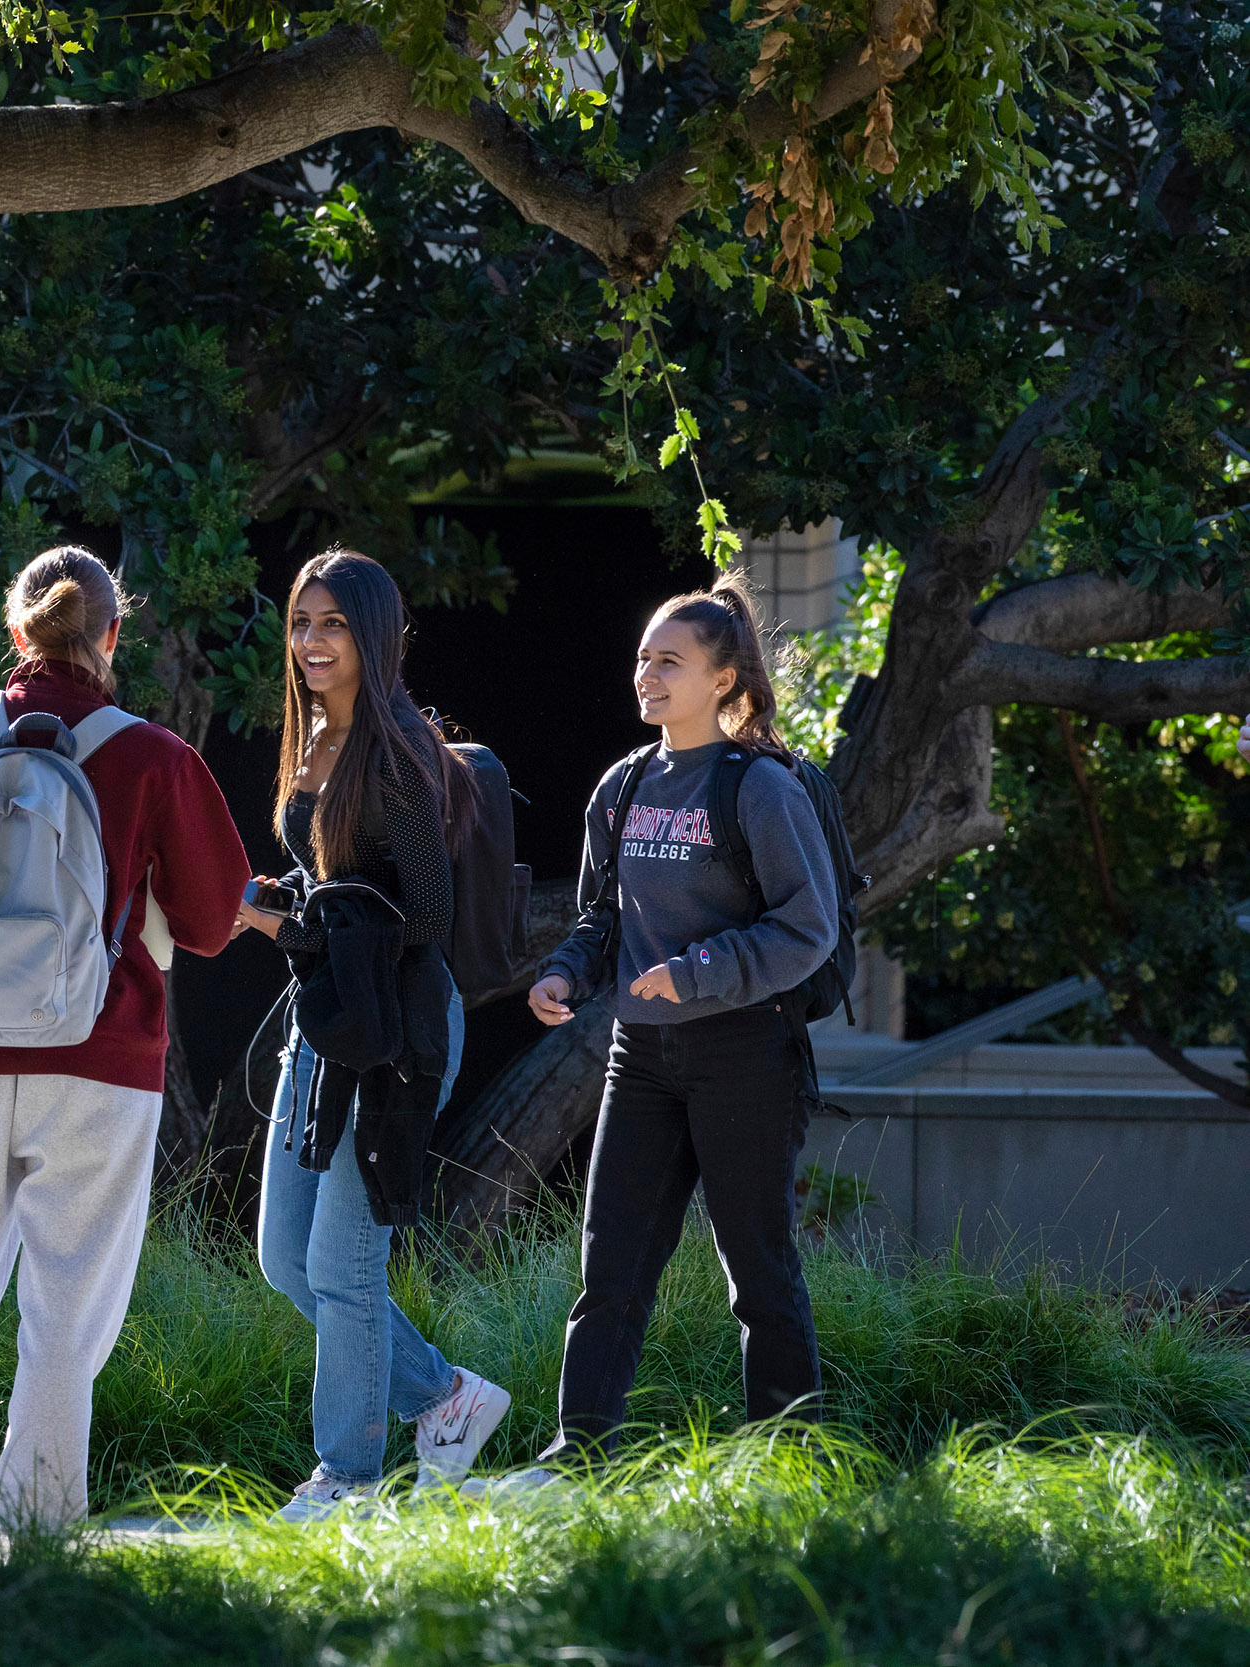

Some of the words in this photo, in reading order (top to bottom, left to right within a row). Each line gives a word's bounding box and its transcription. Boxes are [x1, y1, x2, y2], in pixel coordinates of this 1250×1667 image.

[607, 804, 674, 841] EMONT
[668, 808, 716, 846] McKE
[623, 842, 691, 861] COLLEGE
